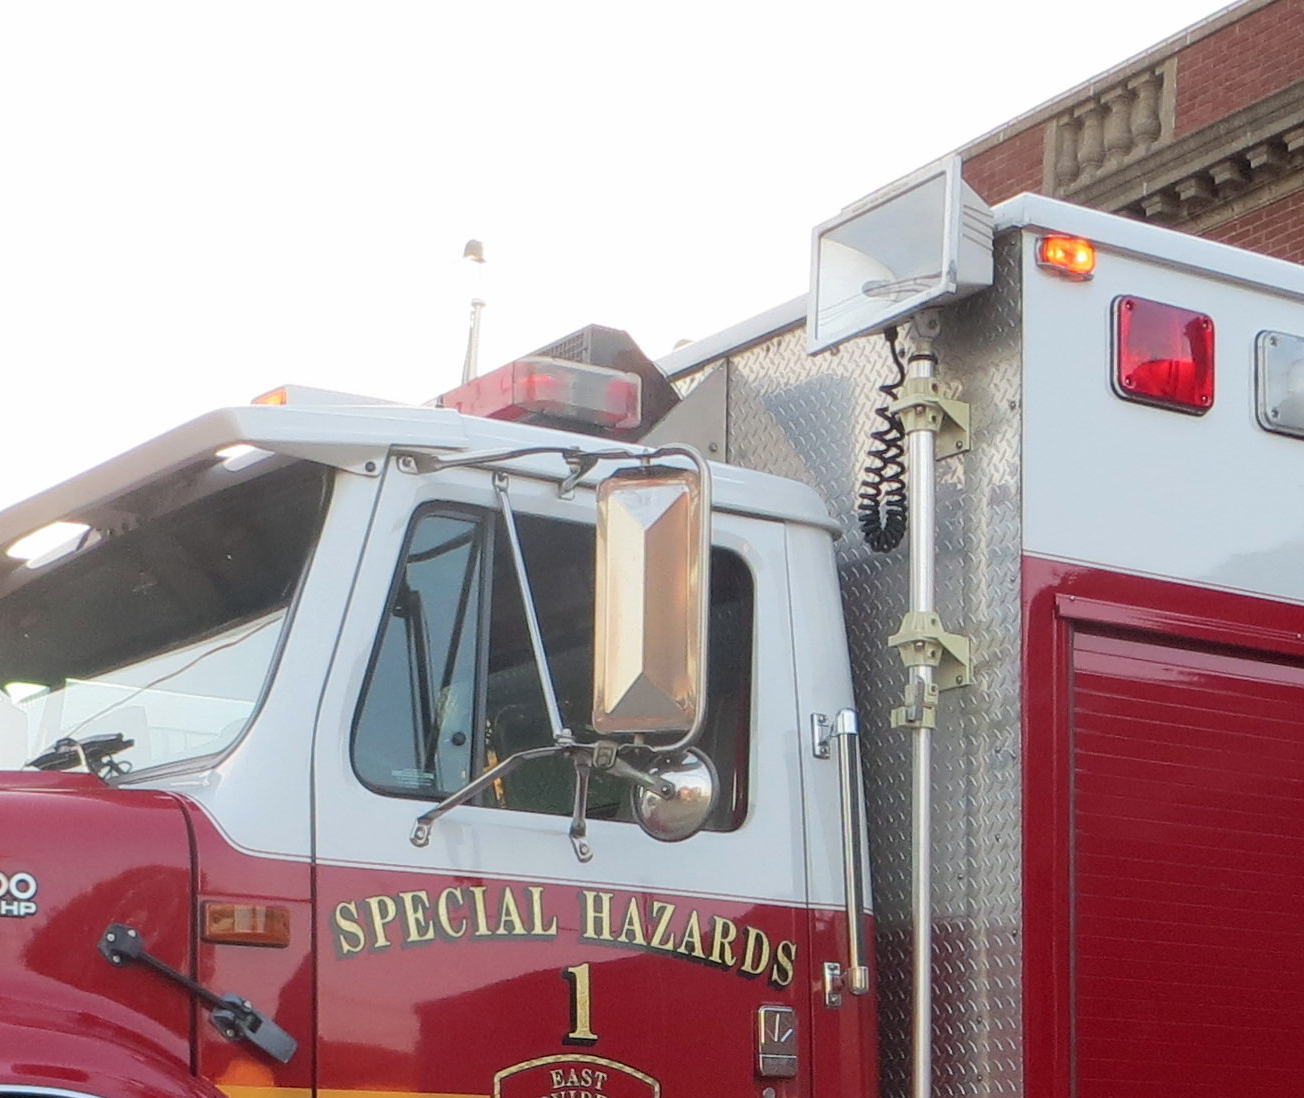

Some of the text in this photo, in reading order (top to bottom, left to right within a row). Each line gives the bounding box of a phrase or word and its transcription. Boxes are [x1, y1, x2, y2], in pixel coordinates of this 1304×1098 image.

[0, 900, 37, 916] HP
[333, 885, 797, 988] SPECIAL HAZARDS
[563, 962, 598, 1046] 1
[550, 1068, 608, 1091] EAST
